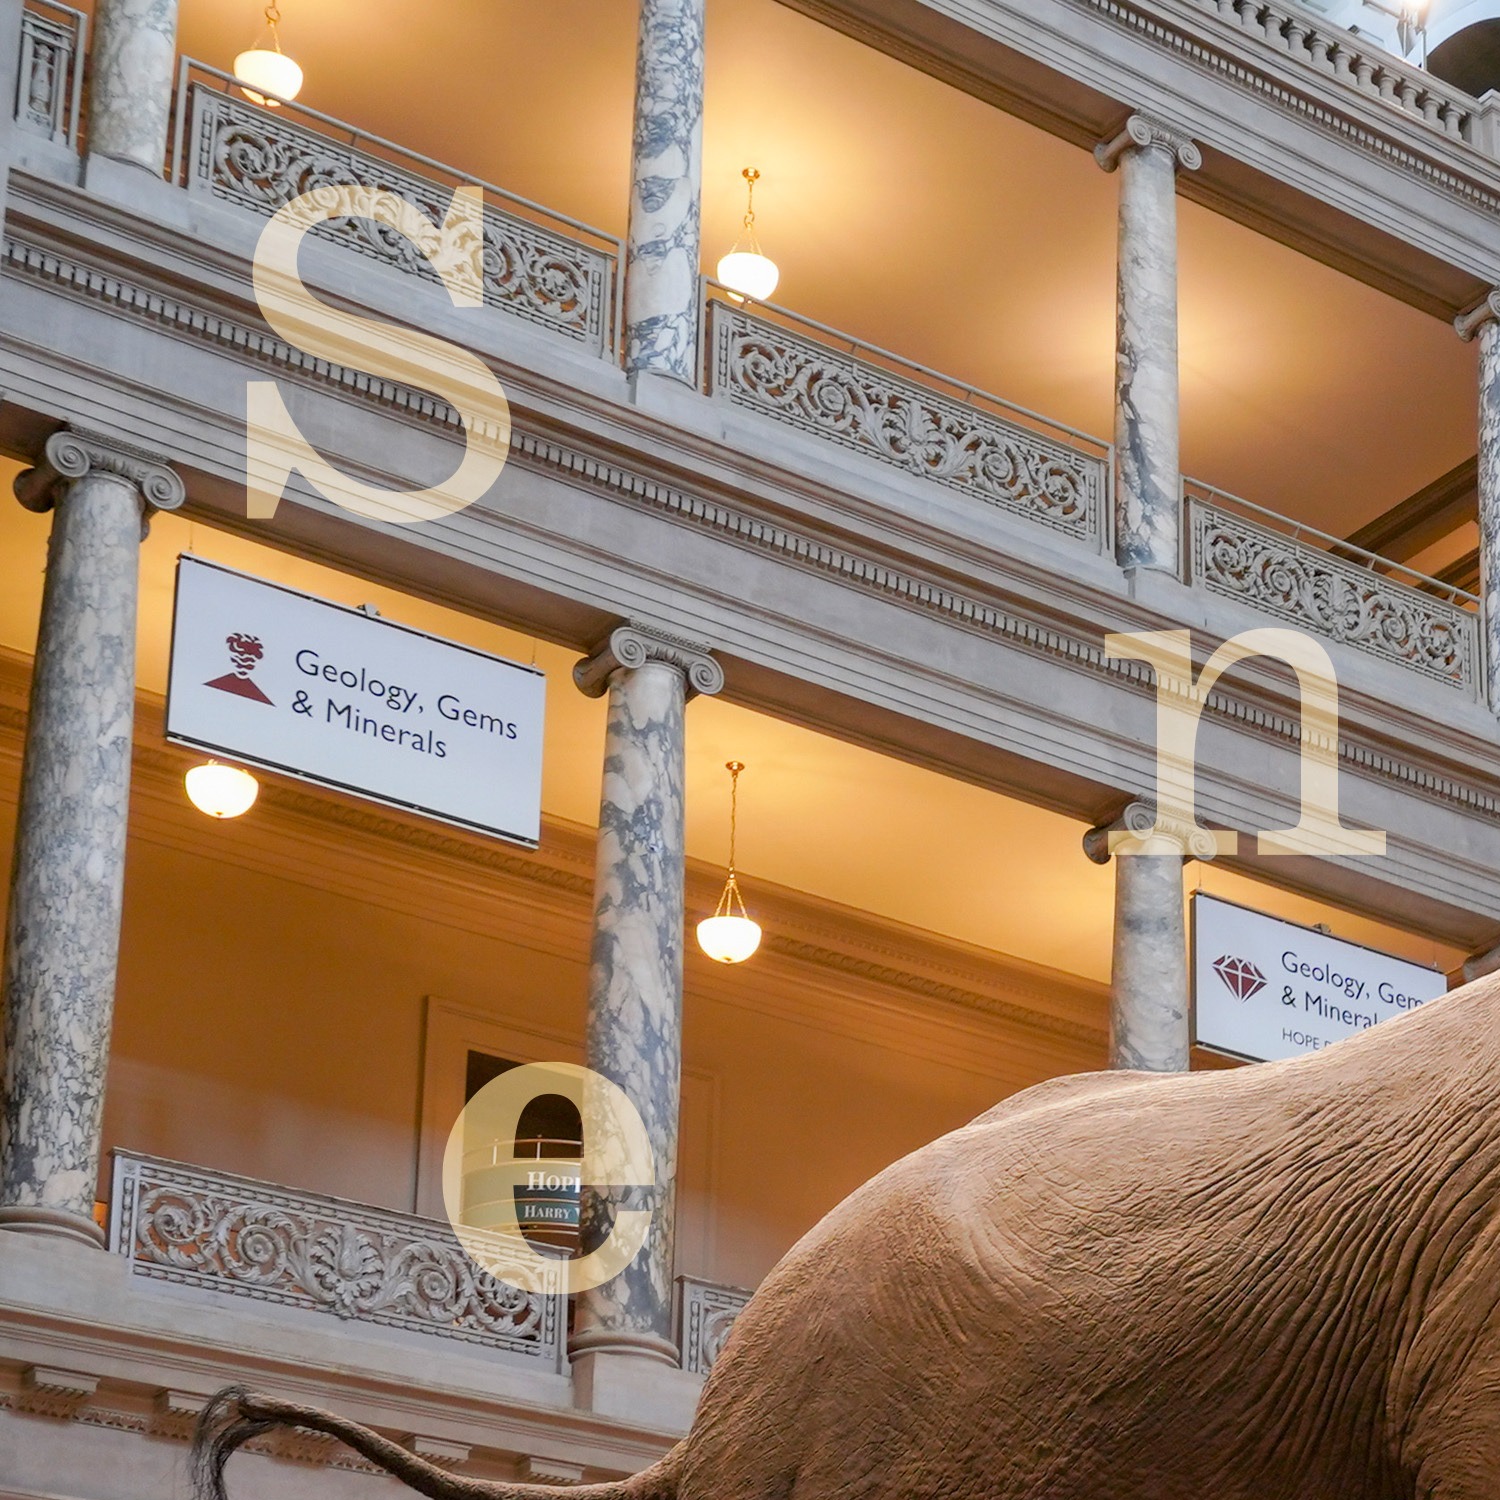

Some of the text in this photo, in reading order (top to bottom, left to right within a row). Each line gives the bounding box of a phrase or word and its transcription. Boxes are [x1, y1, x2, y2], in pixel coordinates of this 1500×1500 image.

[291, 688, 448, 758] & Minerals
[295, 648, 519, 741] Geology, Gems
[1281, 951, 1424, 1010] Geology, Gem
[1281, 985, 1386, 1030] & Mineral
[1282, 1028, 1320, 1051] HOPE
